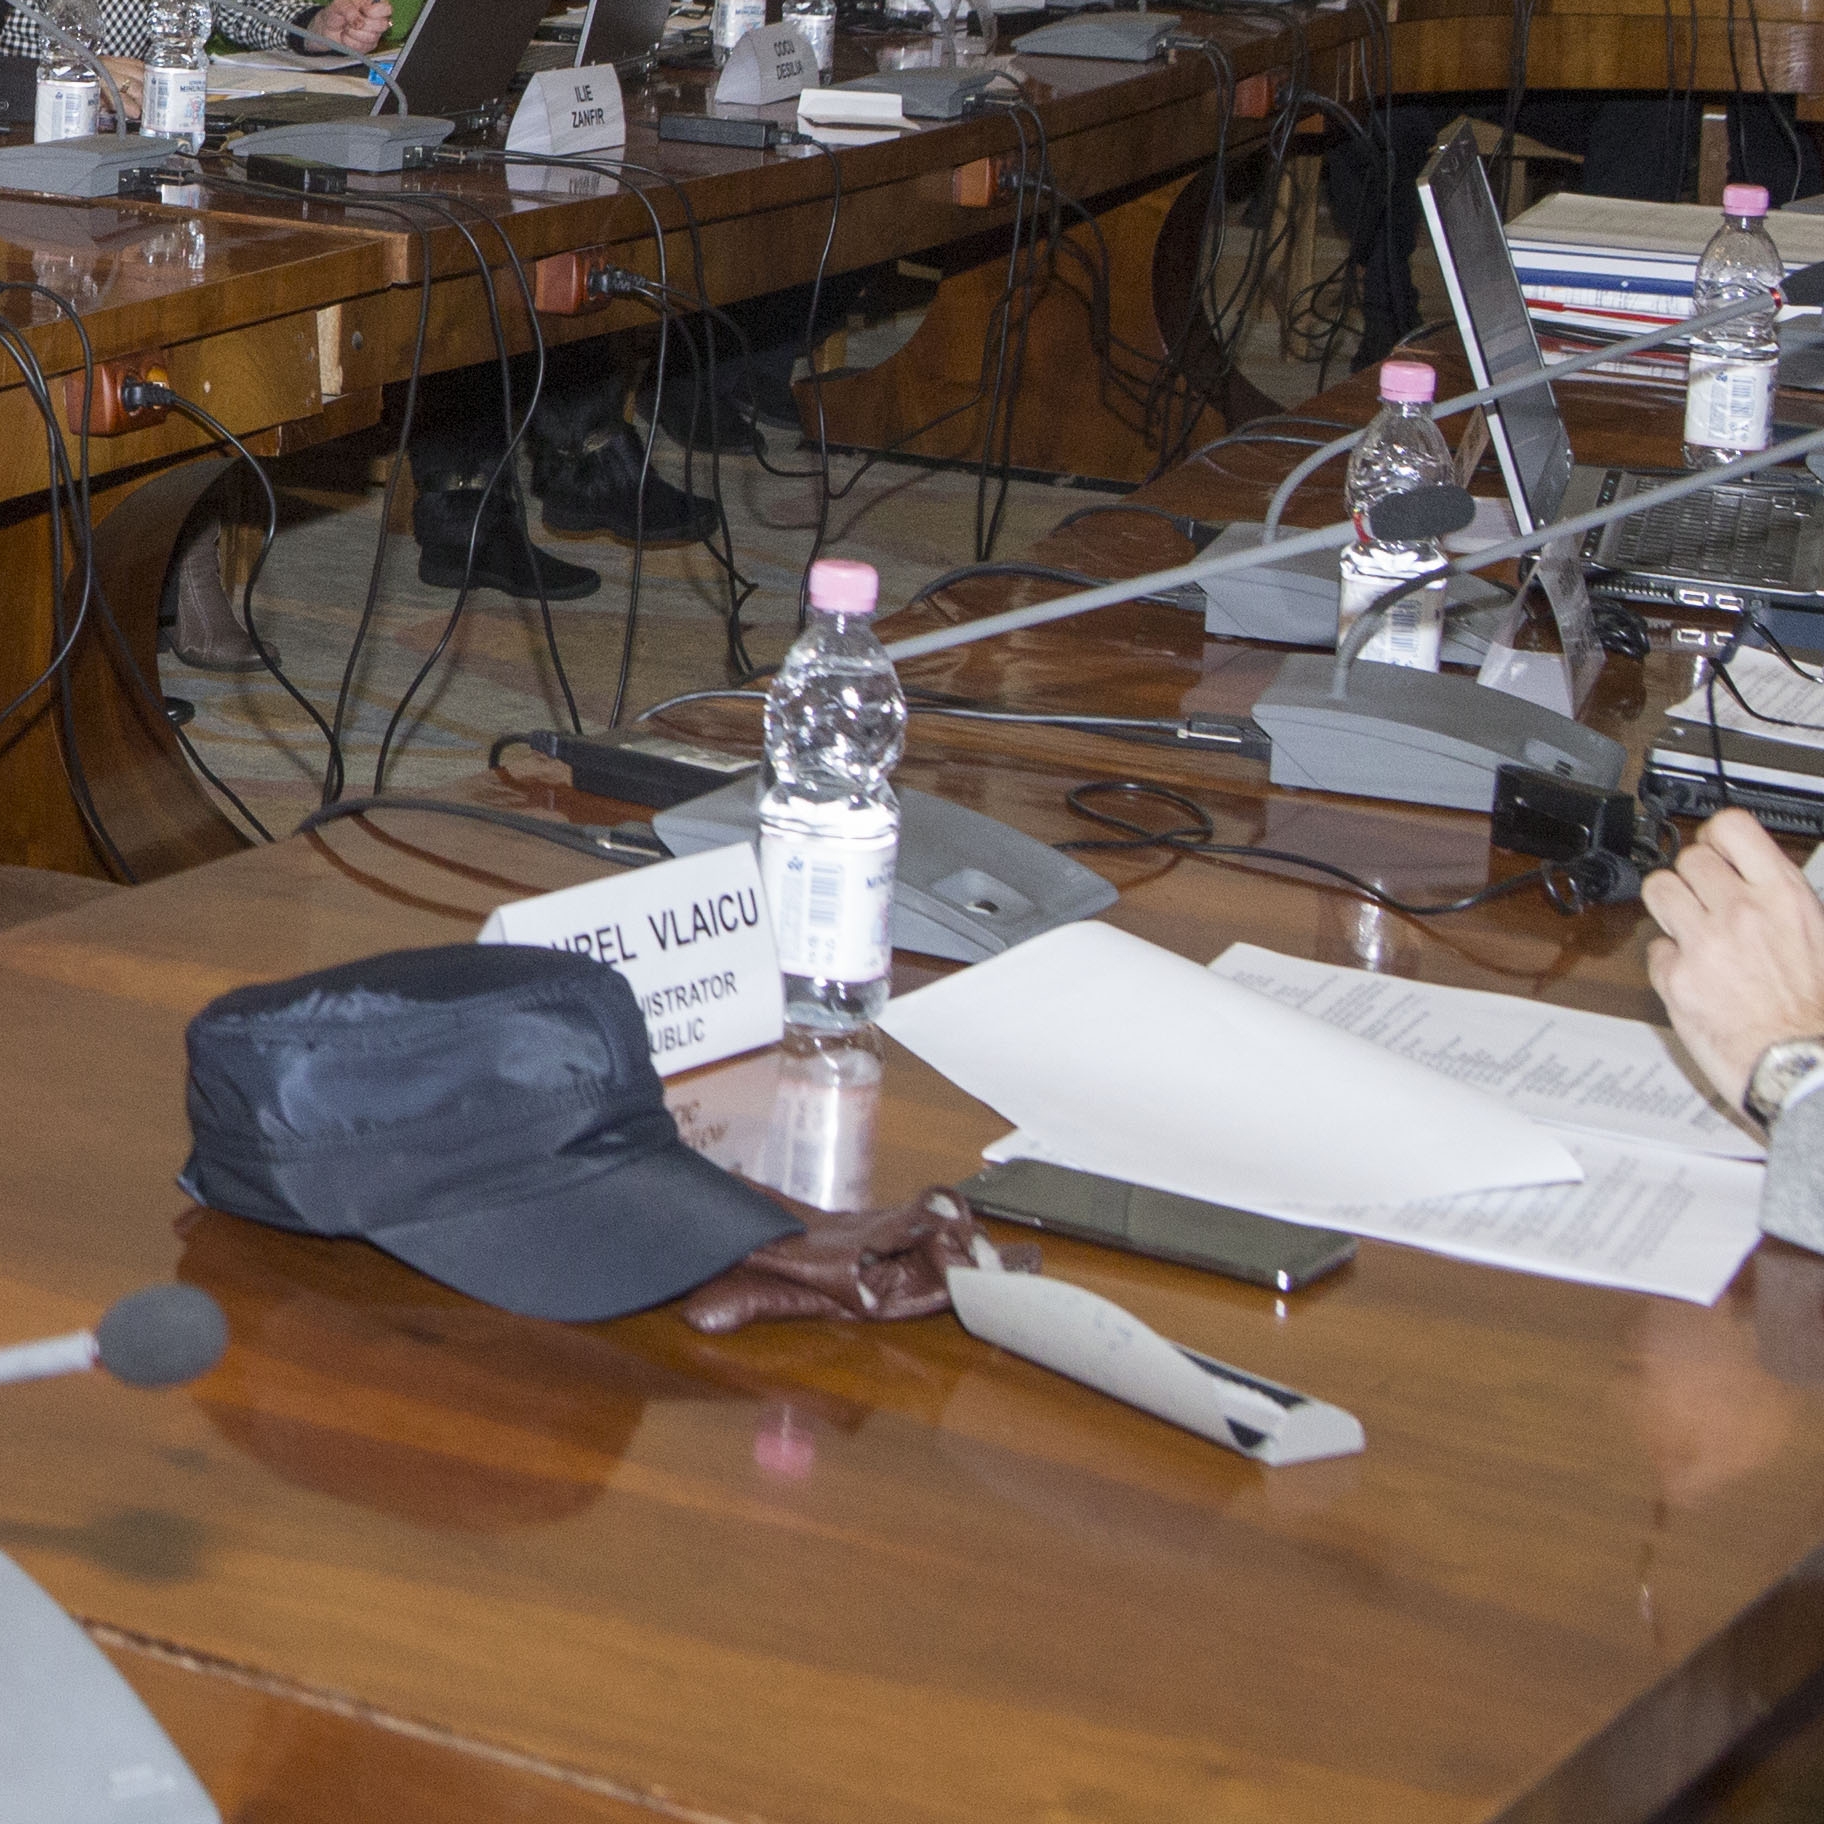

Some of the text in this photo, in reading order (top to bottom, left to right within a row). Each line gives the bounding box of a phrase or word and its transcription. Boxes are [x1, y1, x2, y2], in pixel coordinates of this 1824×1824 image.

[574, 84, 594, 103] ILIE
[571, 107, 605, 129] ZANFIR
[648, 887, 759, 952] VLAICU
[650, 1017, 705, 1055] UBLIC
